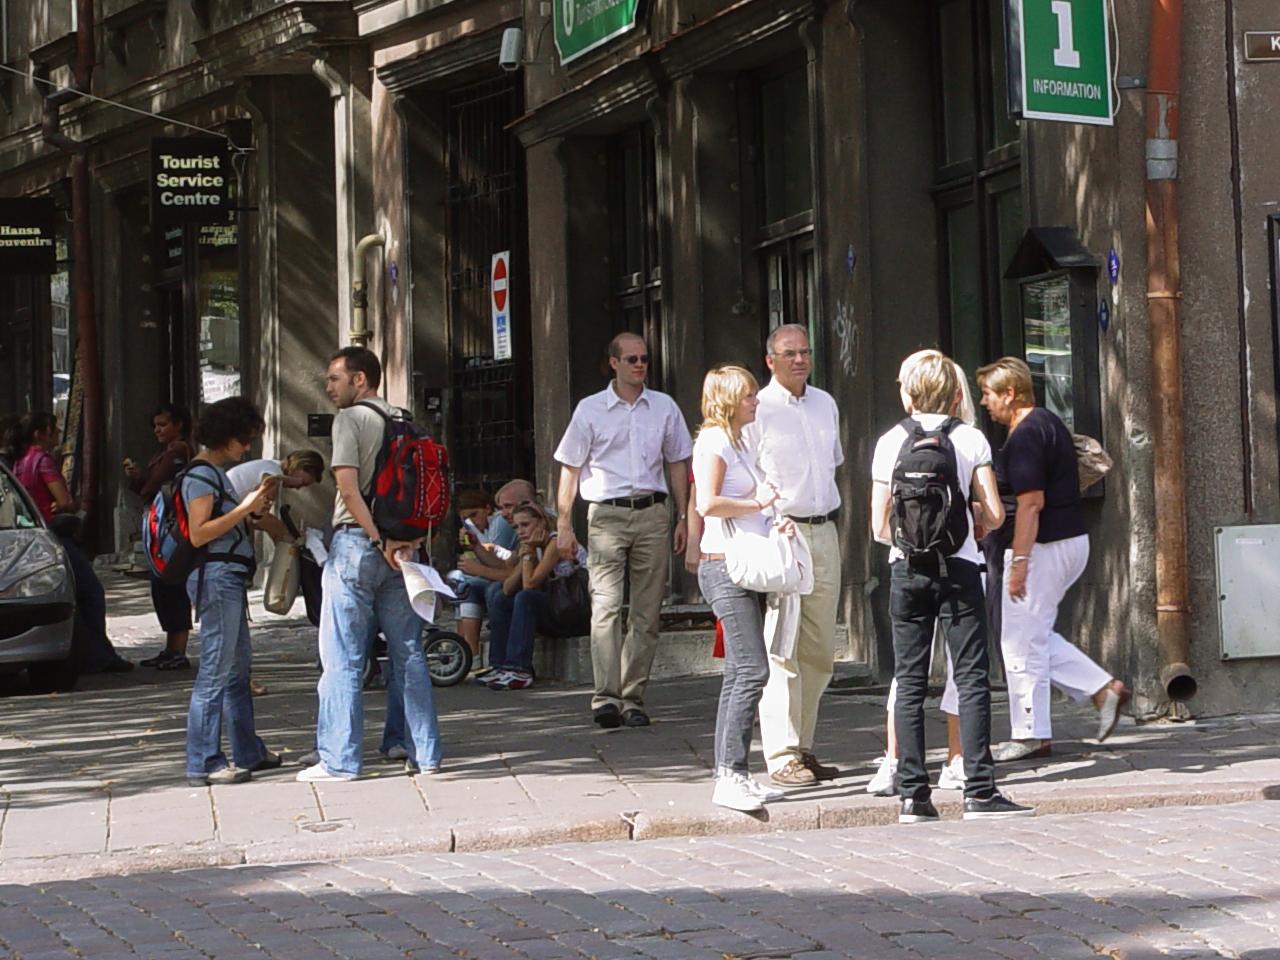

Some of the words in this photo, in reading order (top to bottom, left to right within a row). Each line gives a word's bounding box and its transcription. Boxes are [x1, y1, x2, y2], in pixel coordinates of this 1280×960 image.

[1032, 78, 1102, 101] INFORMATION
[159, 154, 221, 170] Tourist
[156, 173, 224, 188] Service
[160, 191, 221, 206] Centre
[0, 225, 42, 236] Hansa
